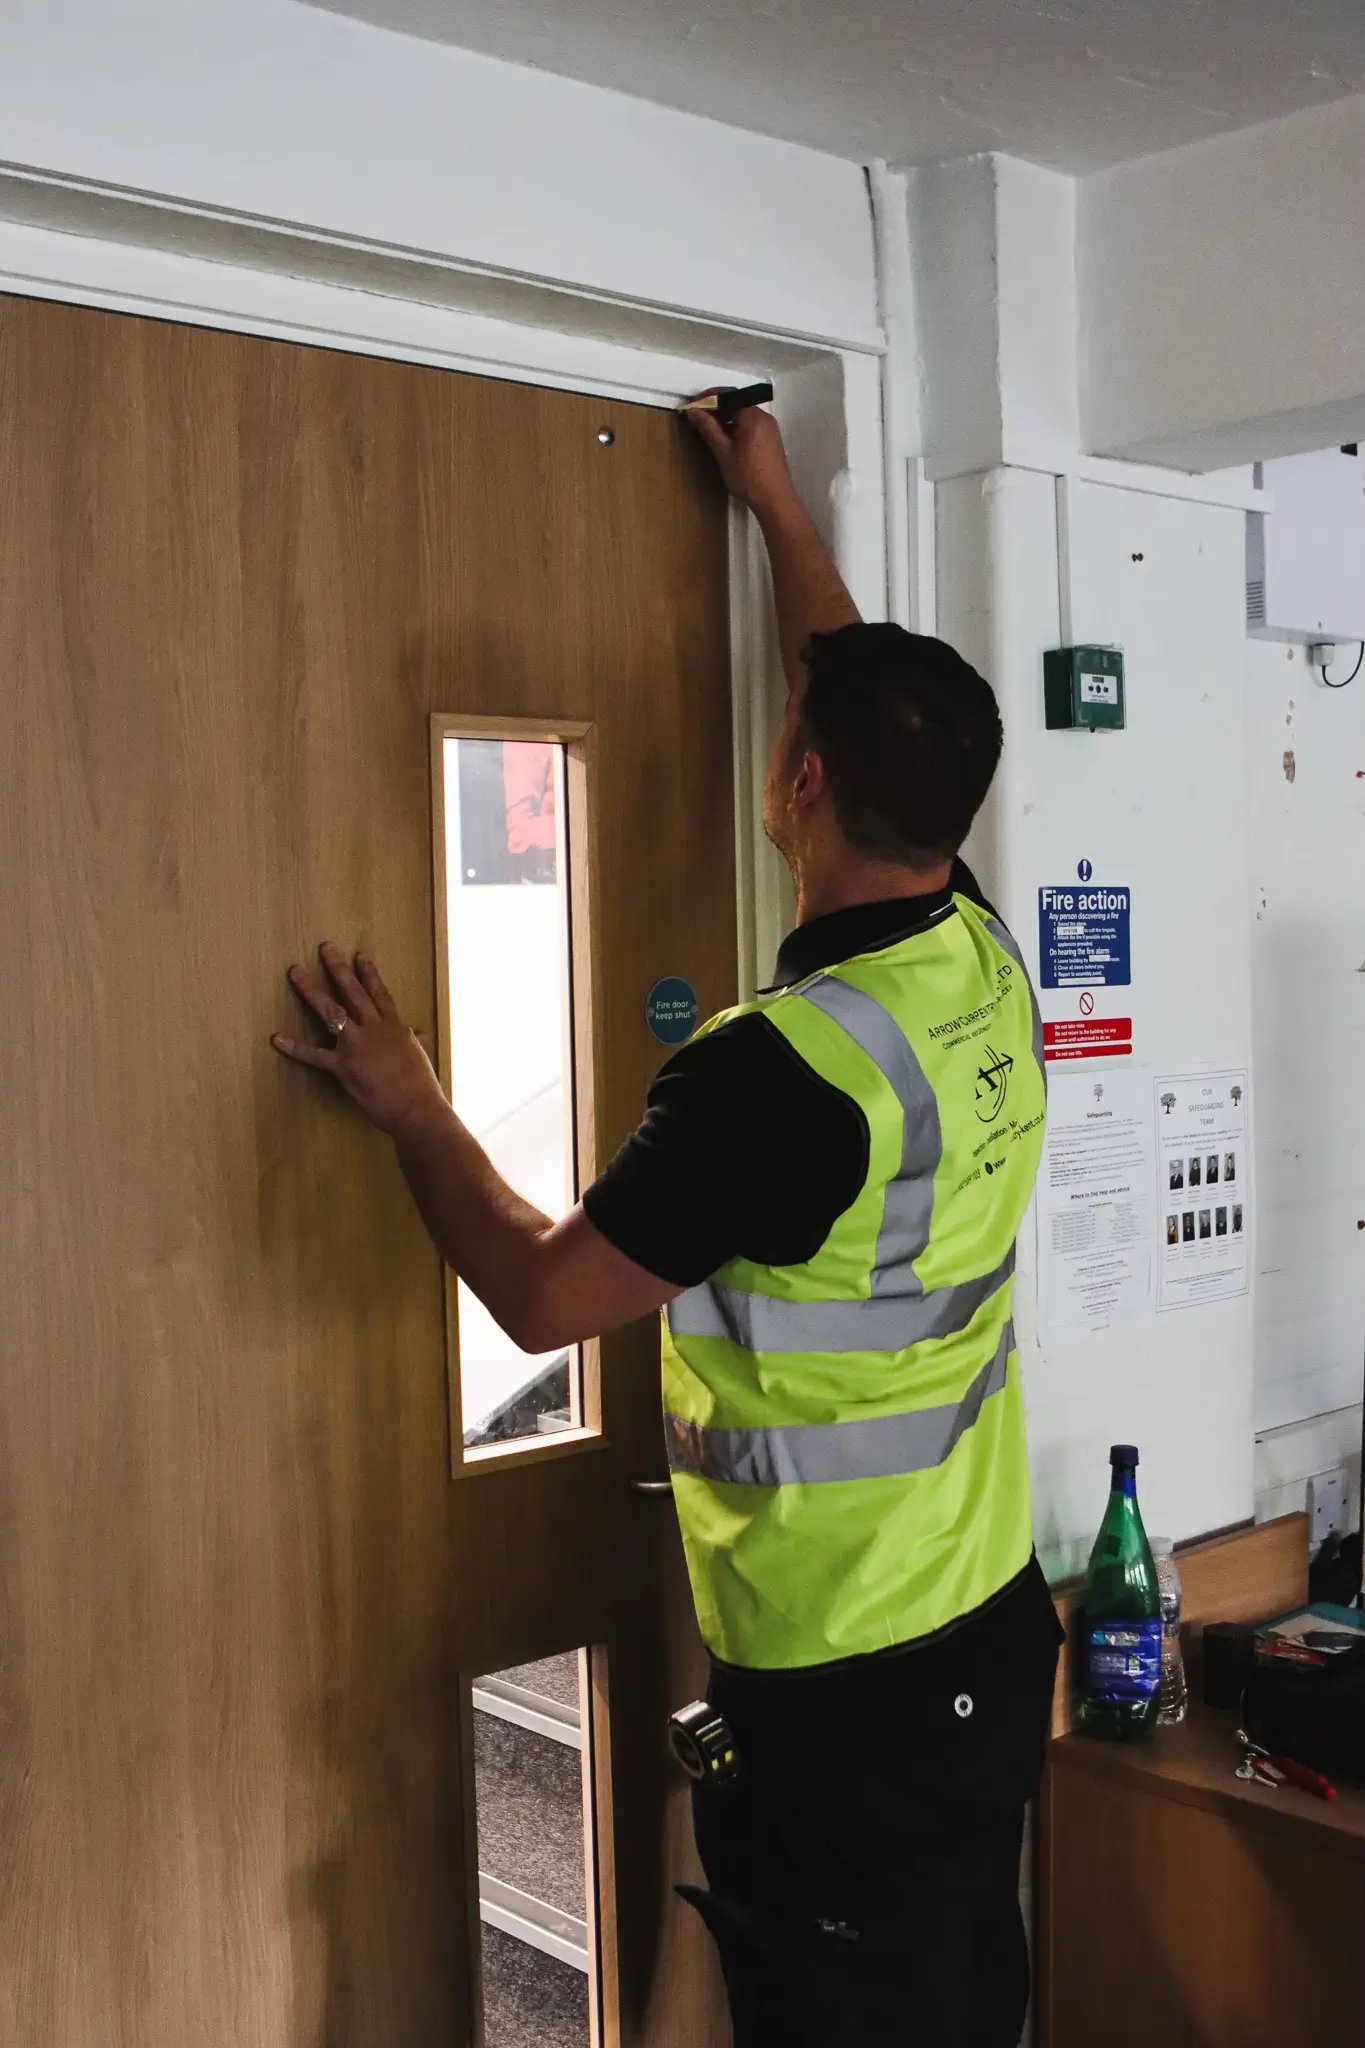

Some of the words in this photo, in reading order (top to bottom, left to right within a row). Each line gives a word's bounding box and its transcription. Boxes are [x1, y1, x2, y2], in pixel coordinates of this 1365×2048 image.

[1042, 890, 1074, 910] Fire
[1078, 890, 1127, 910] action
[1049, 913, 1059, 921] Any
[1078, 912, 1105, 921] discovering
[656, 1001, 670, 1009] Fire
[675, 1011, 690, 1019] shut
[1202, 1088, 1213, 1096] OUR
[1188, 1102, 1224, 1112] SAFEGUARDING
